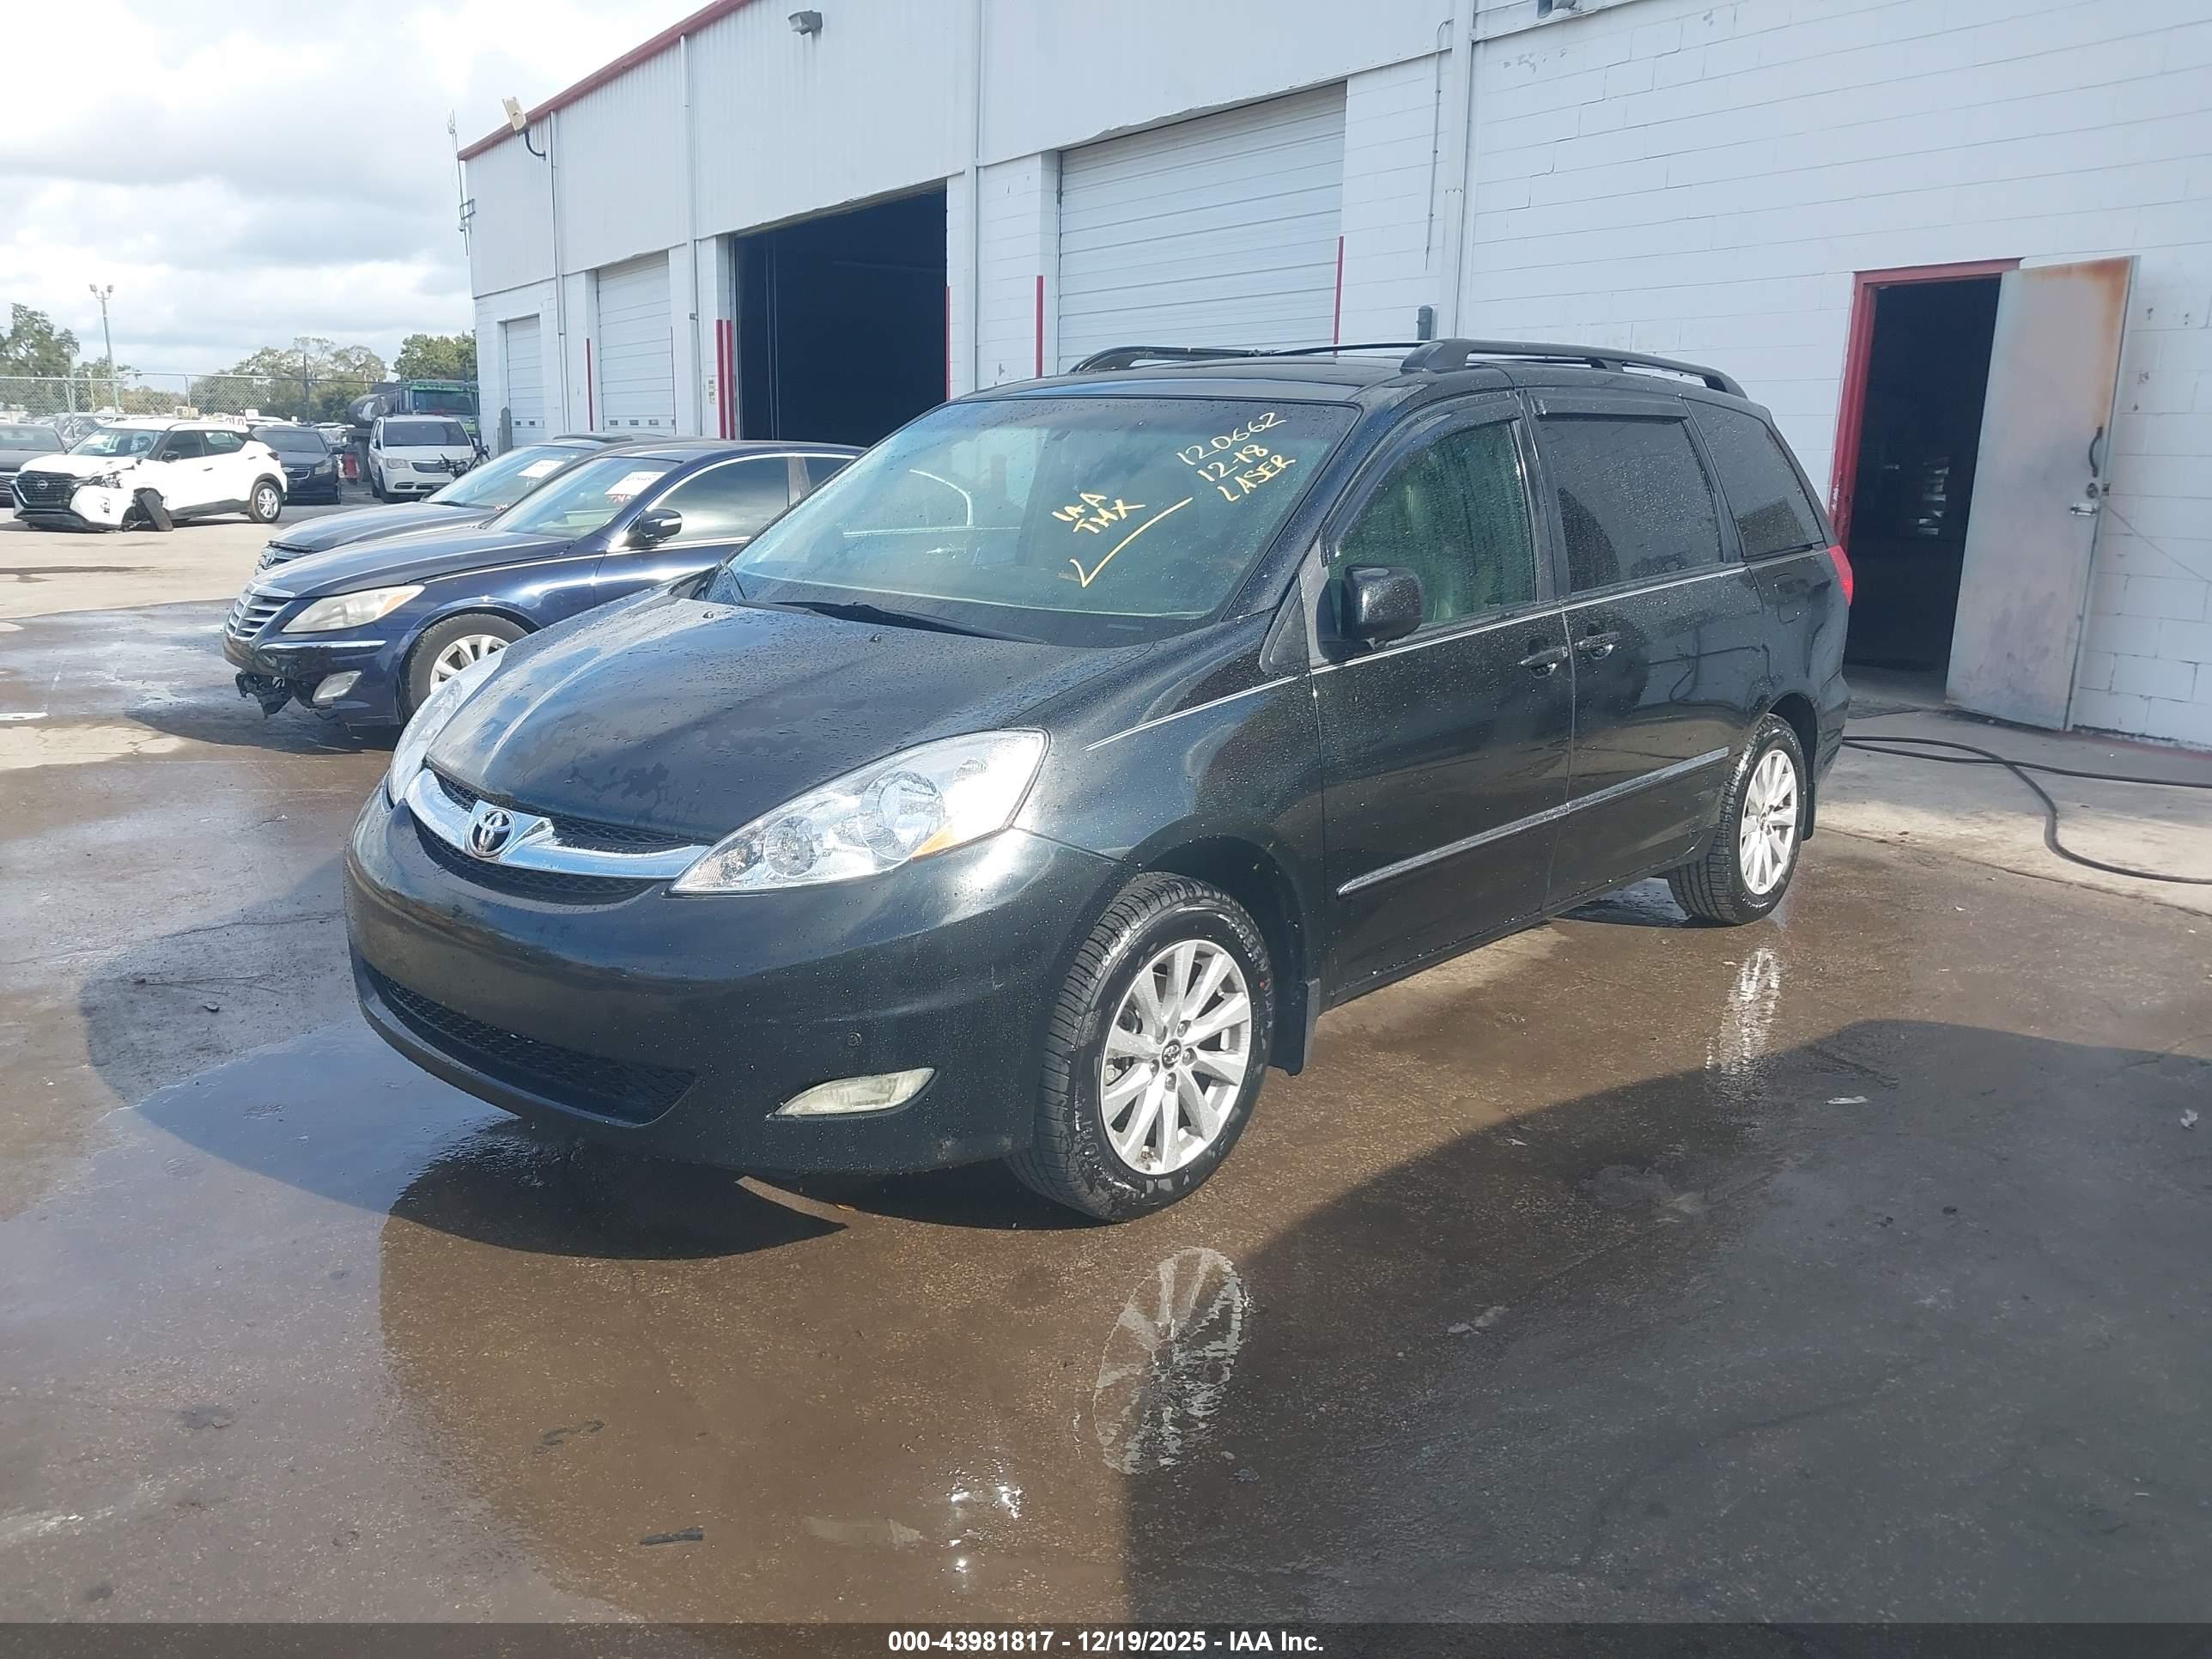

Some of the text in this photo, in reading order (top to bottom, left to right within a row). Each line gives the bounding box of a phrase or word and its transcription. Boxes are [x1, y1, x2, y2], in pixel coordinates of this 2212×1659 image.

[1176, 412, 1287, 465] 120662
[1197, 444, 1269, 482] 12-18
[1216, 454, 1296, 501] LASER
